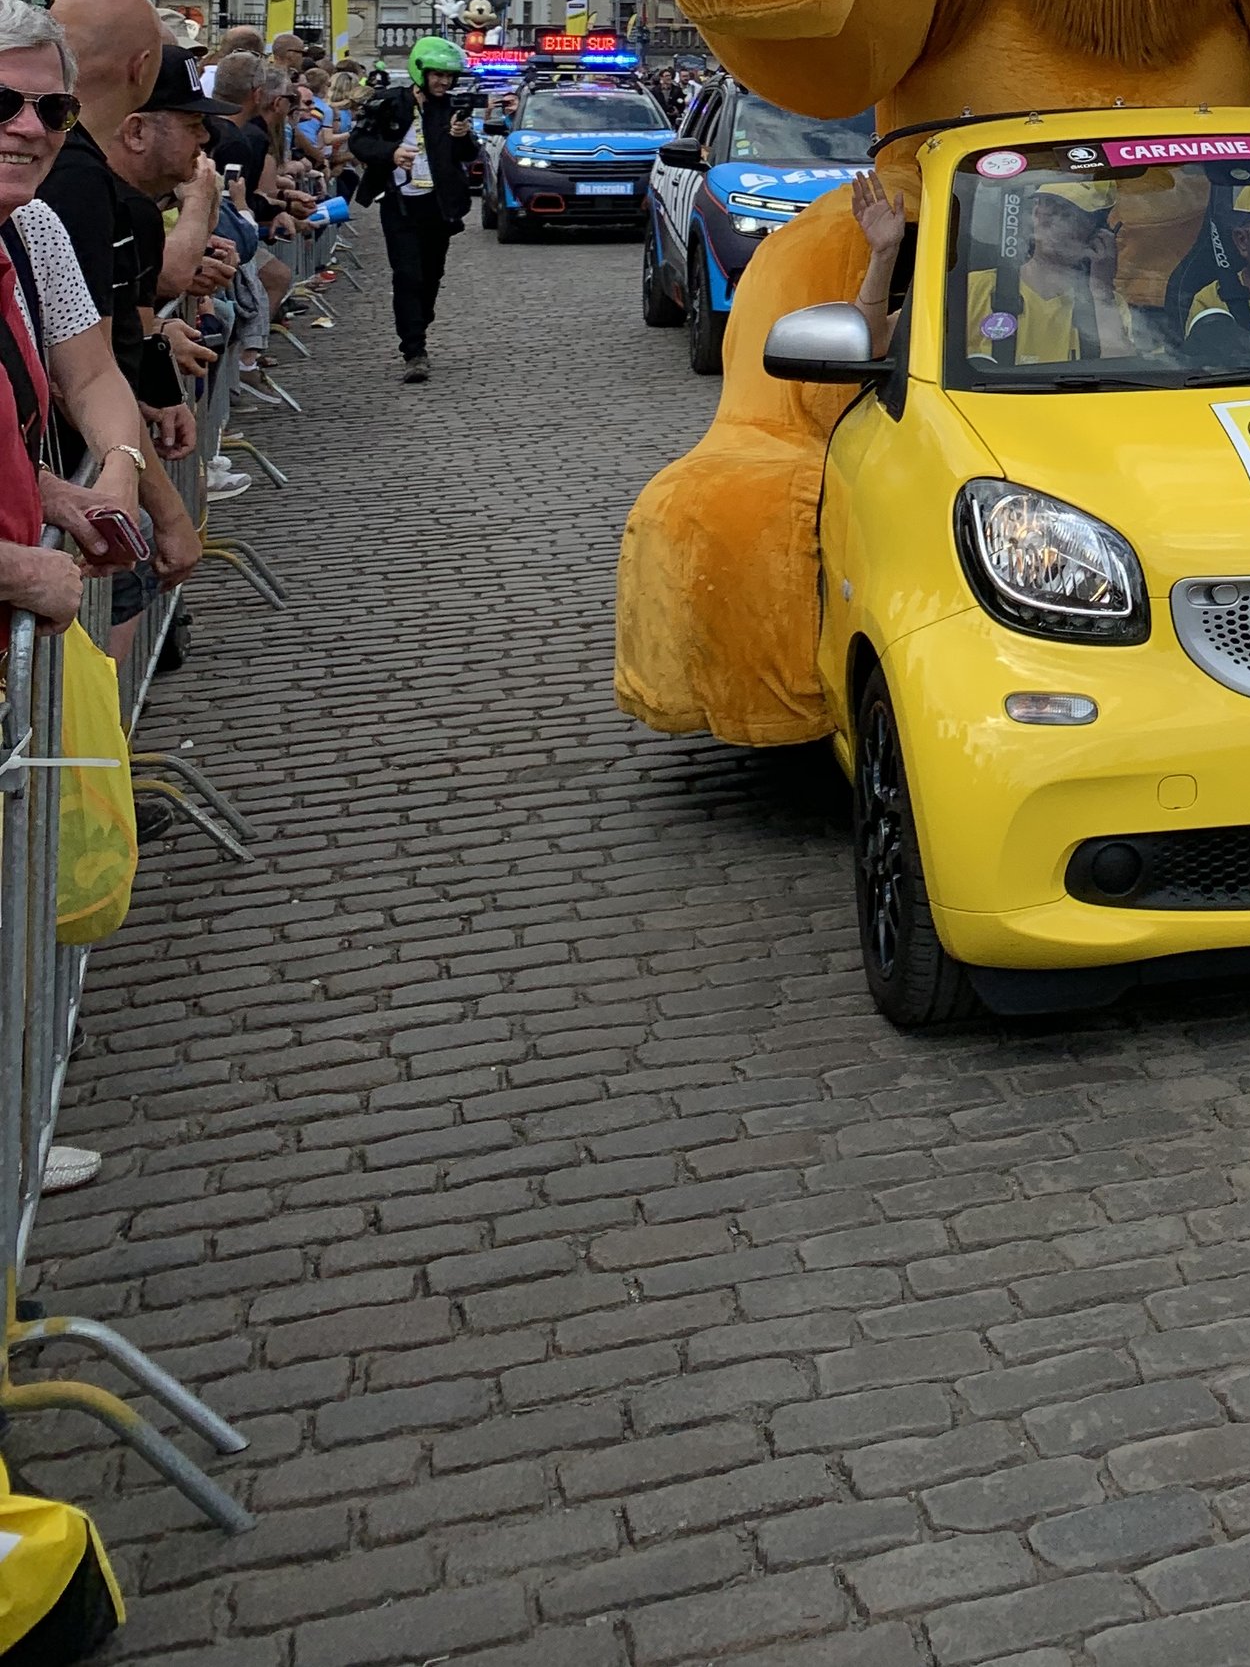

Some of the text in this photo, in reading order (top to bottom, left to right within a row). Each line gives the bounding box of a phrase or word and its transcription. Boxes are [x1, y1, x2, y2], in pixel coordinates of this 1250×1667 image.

[543, 36, 616, 51] BIEN SUR
[1119, 140, 1250, 160] CARAVANE
[1003, 193, 1021, 258] sparco
